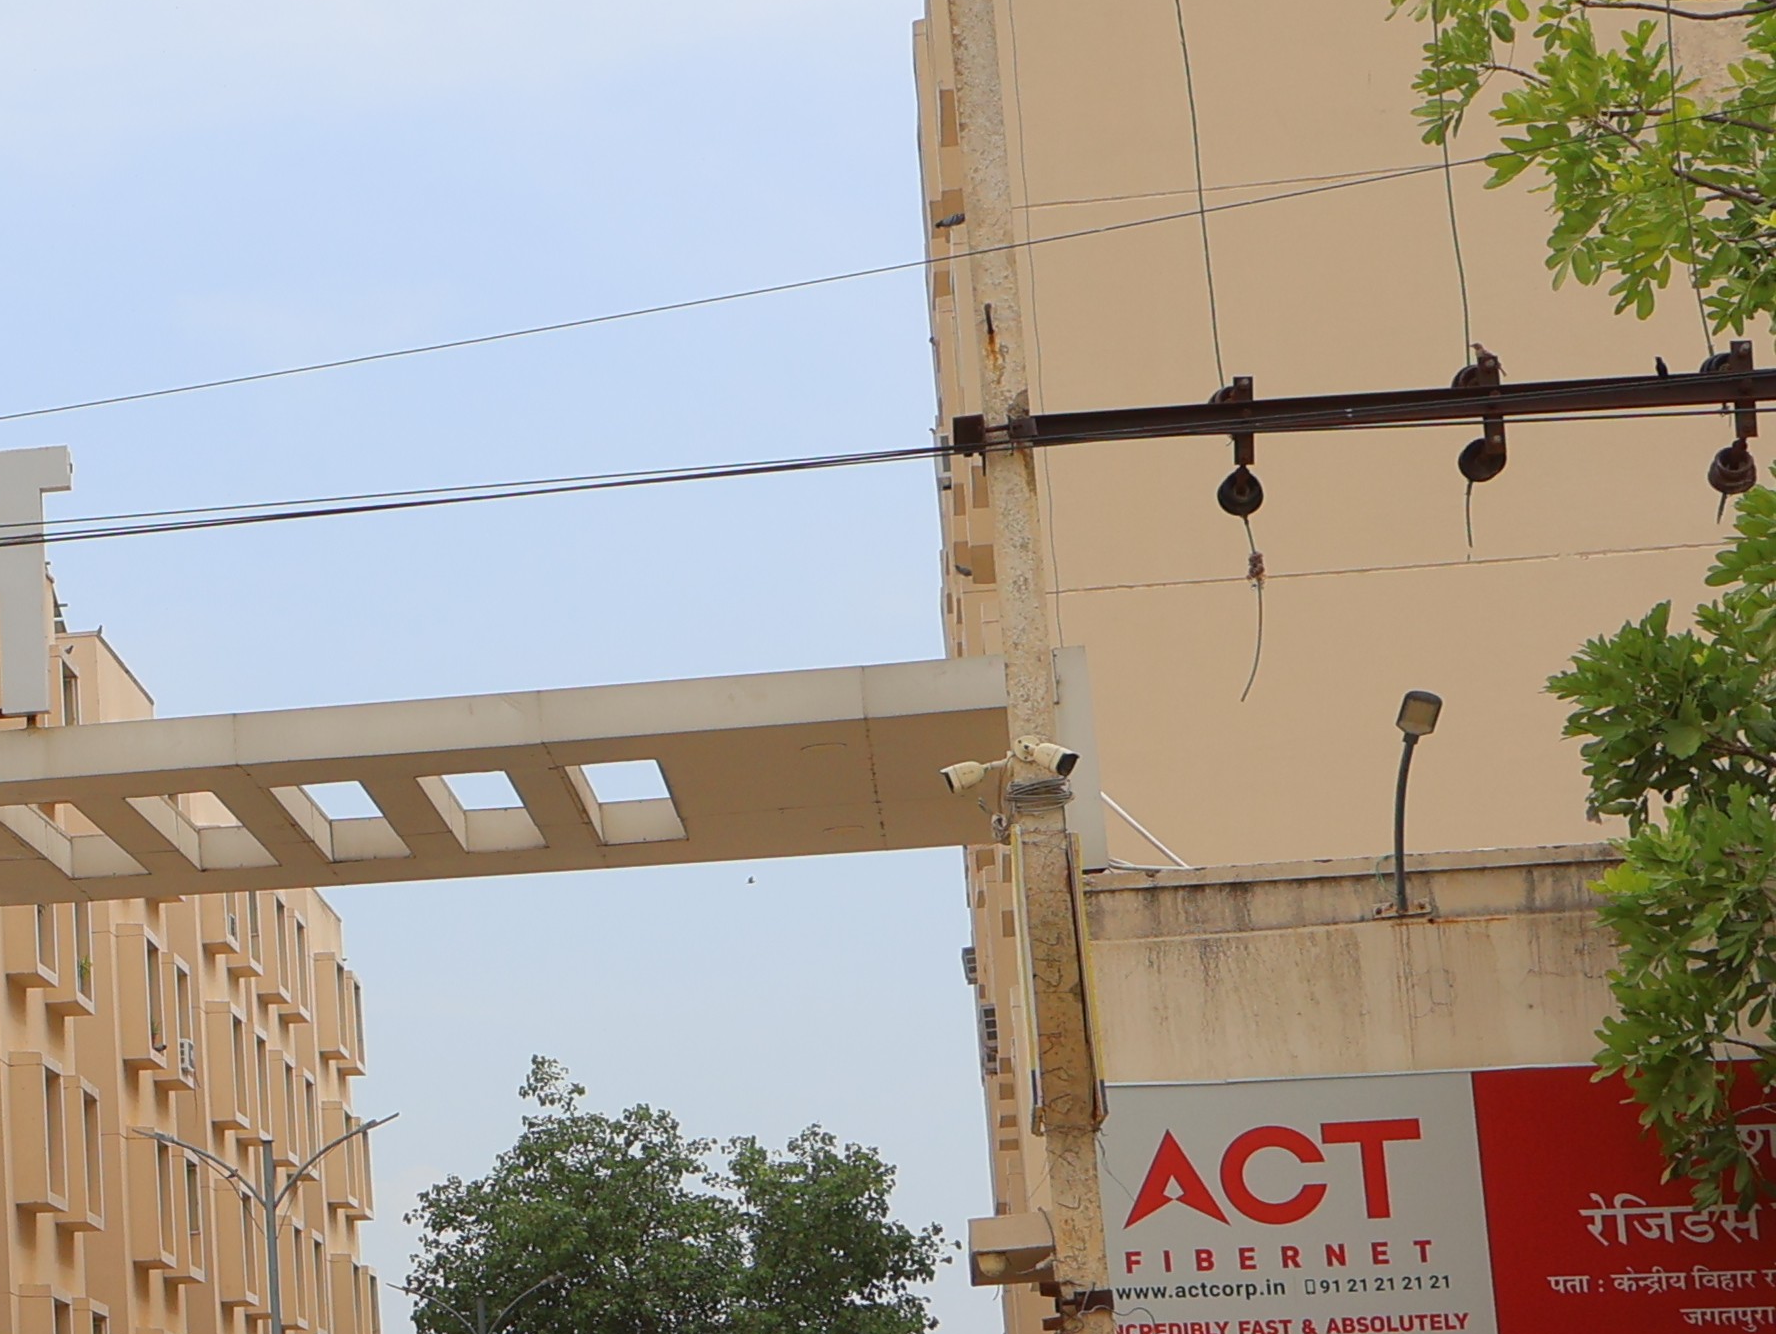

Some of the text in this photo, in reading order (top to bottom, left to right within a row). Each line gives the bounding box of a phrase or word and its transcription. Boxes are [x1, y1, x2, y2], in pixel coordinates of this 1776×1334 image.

[1123, 1117, 1422, 1230] ACT
[1124, 1240, 1432, 1274] FIBERNET
[1116, 1279, 1286, 1301] www.actcorp.in
[1547, 1275, 1591, 1294] पता
[1610, 1266, 1688, 1295] केन्द्रीय
[1692, 1265, 1757, 1292] विहार
[1325, 1312, 1470, 1334] ABSOLUTELY
[1679, 1306, 1776, 1333] जगतपुरा
